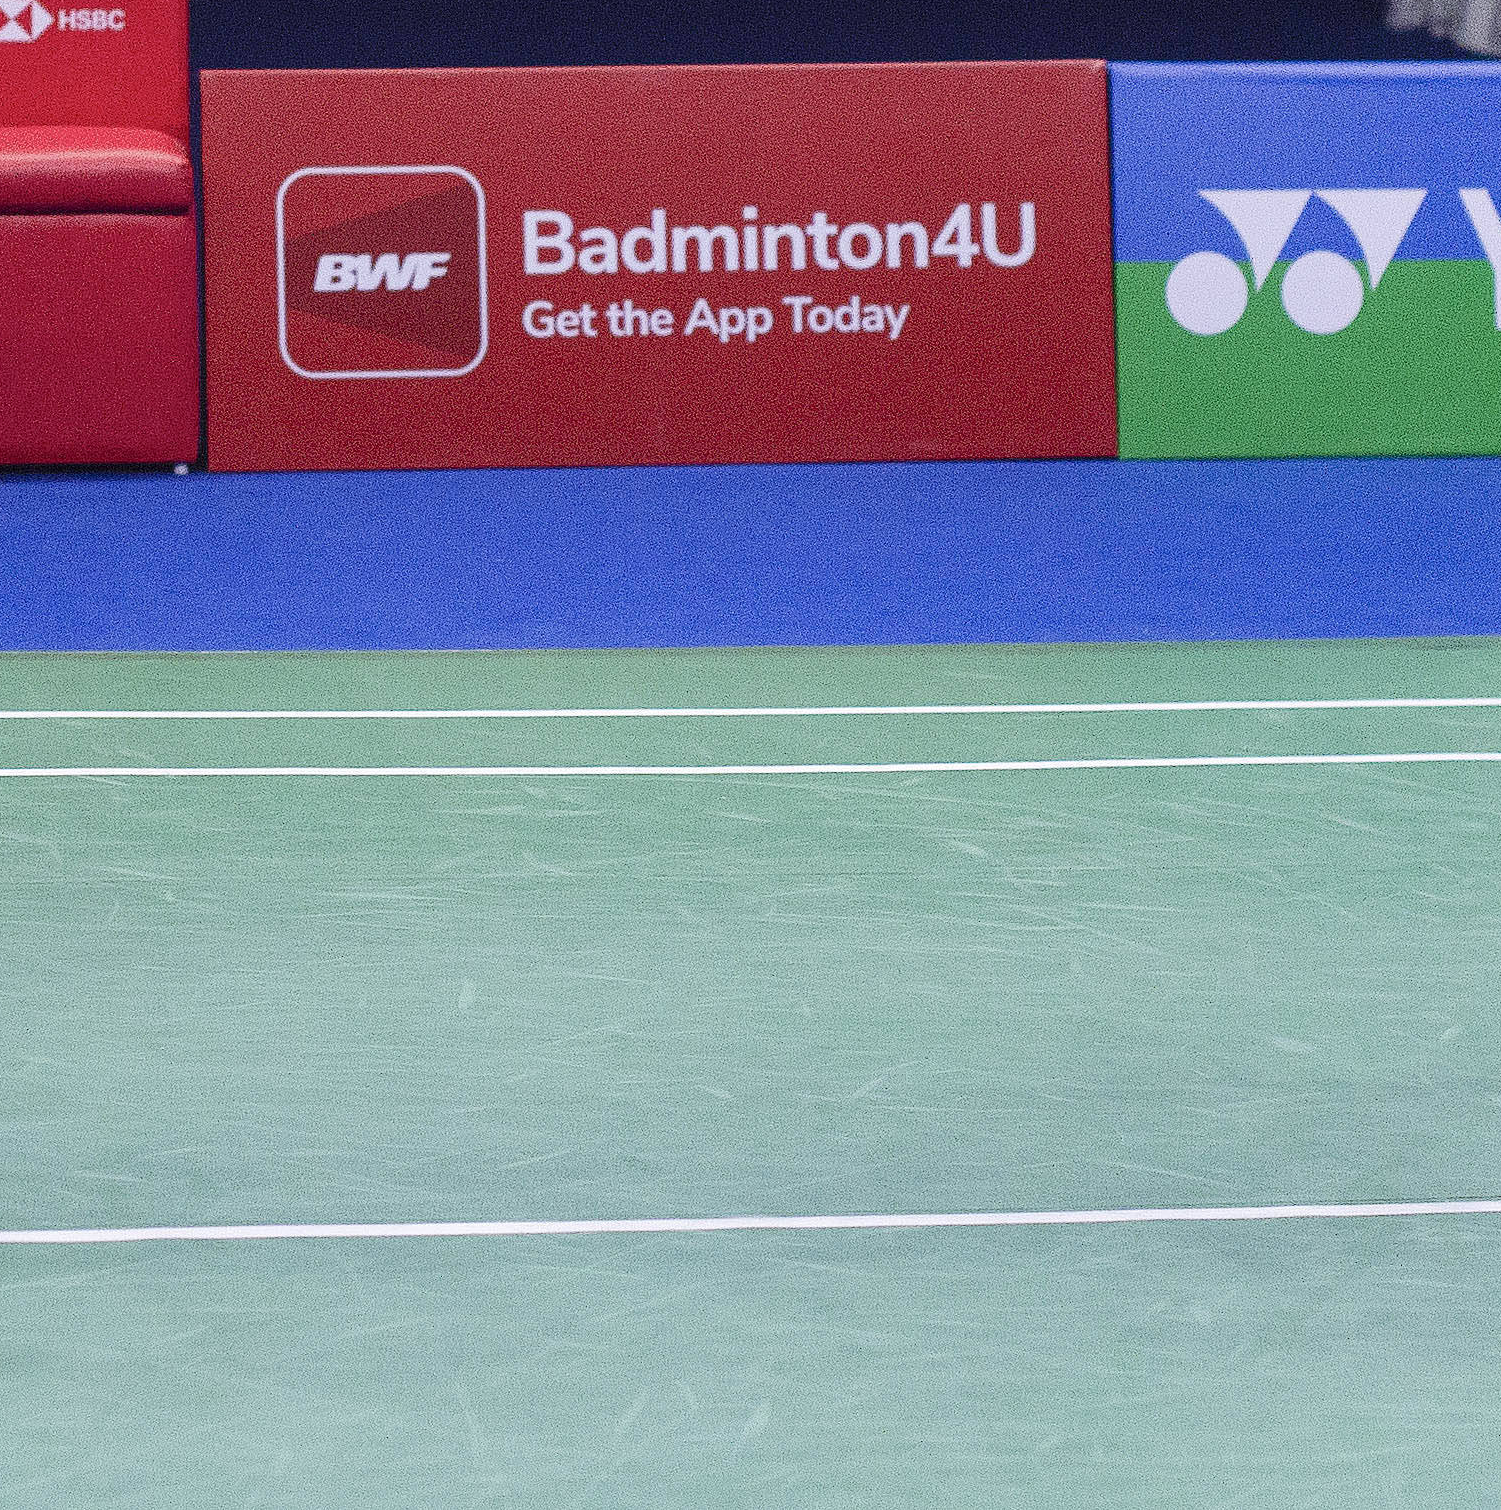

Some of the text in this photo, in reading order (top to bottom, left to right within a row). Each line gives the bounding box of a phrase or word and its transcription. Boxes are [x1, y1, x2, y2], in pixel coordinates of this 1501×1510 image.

[57, 8, 126, 31] HSBC
[521, 201, 1037, 276] Badminton4U
[313, 252, 452, 293] BWF
[520, 294, 911, 344] Get the App Today
